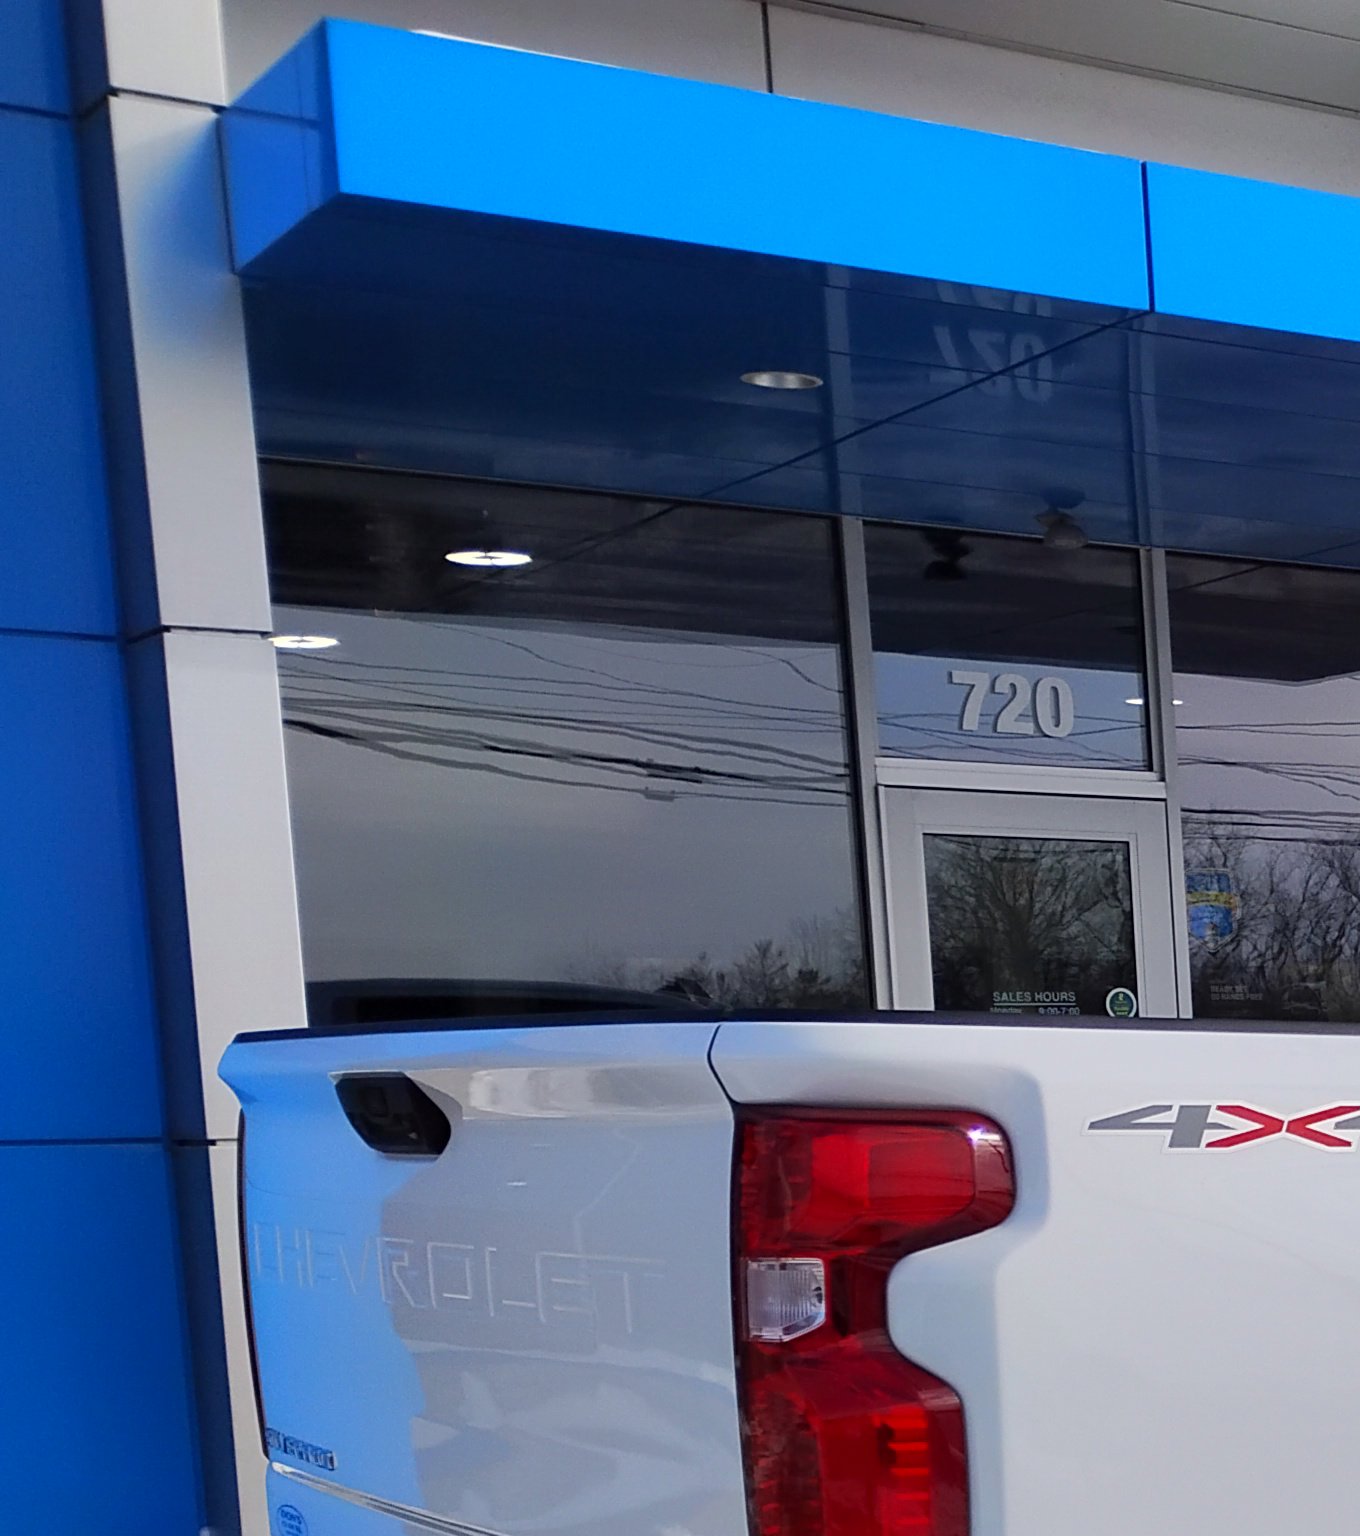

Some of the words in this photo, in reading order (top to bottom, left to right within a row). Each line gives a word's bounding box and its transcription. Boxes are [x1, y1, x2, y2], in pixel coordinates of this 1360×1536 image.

[948, 669, 1074, 738] 720
[992, 991, 1032, 1002] SALES
[1034, 991, 1077, 1002] HOURS
[254, 1219, 666, 1335] CHEVROLET
